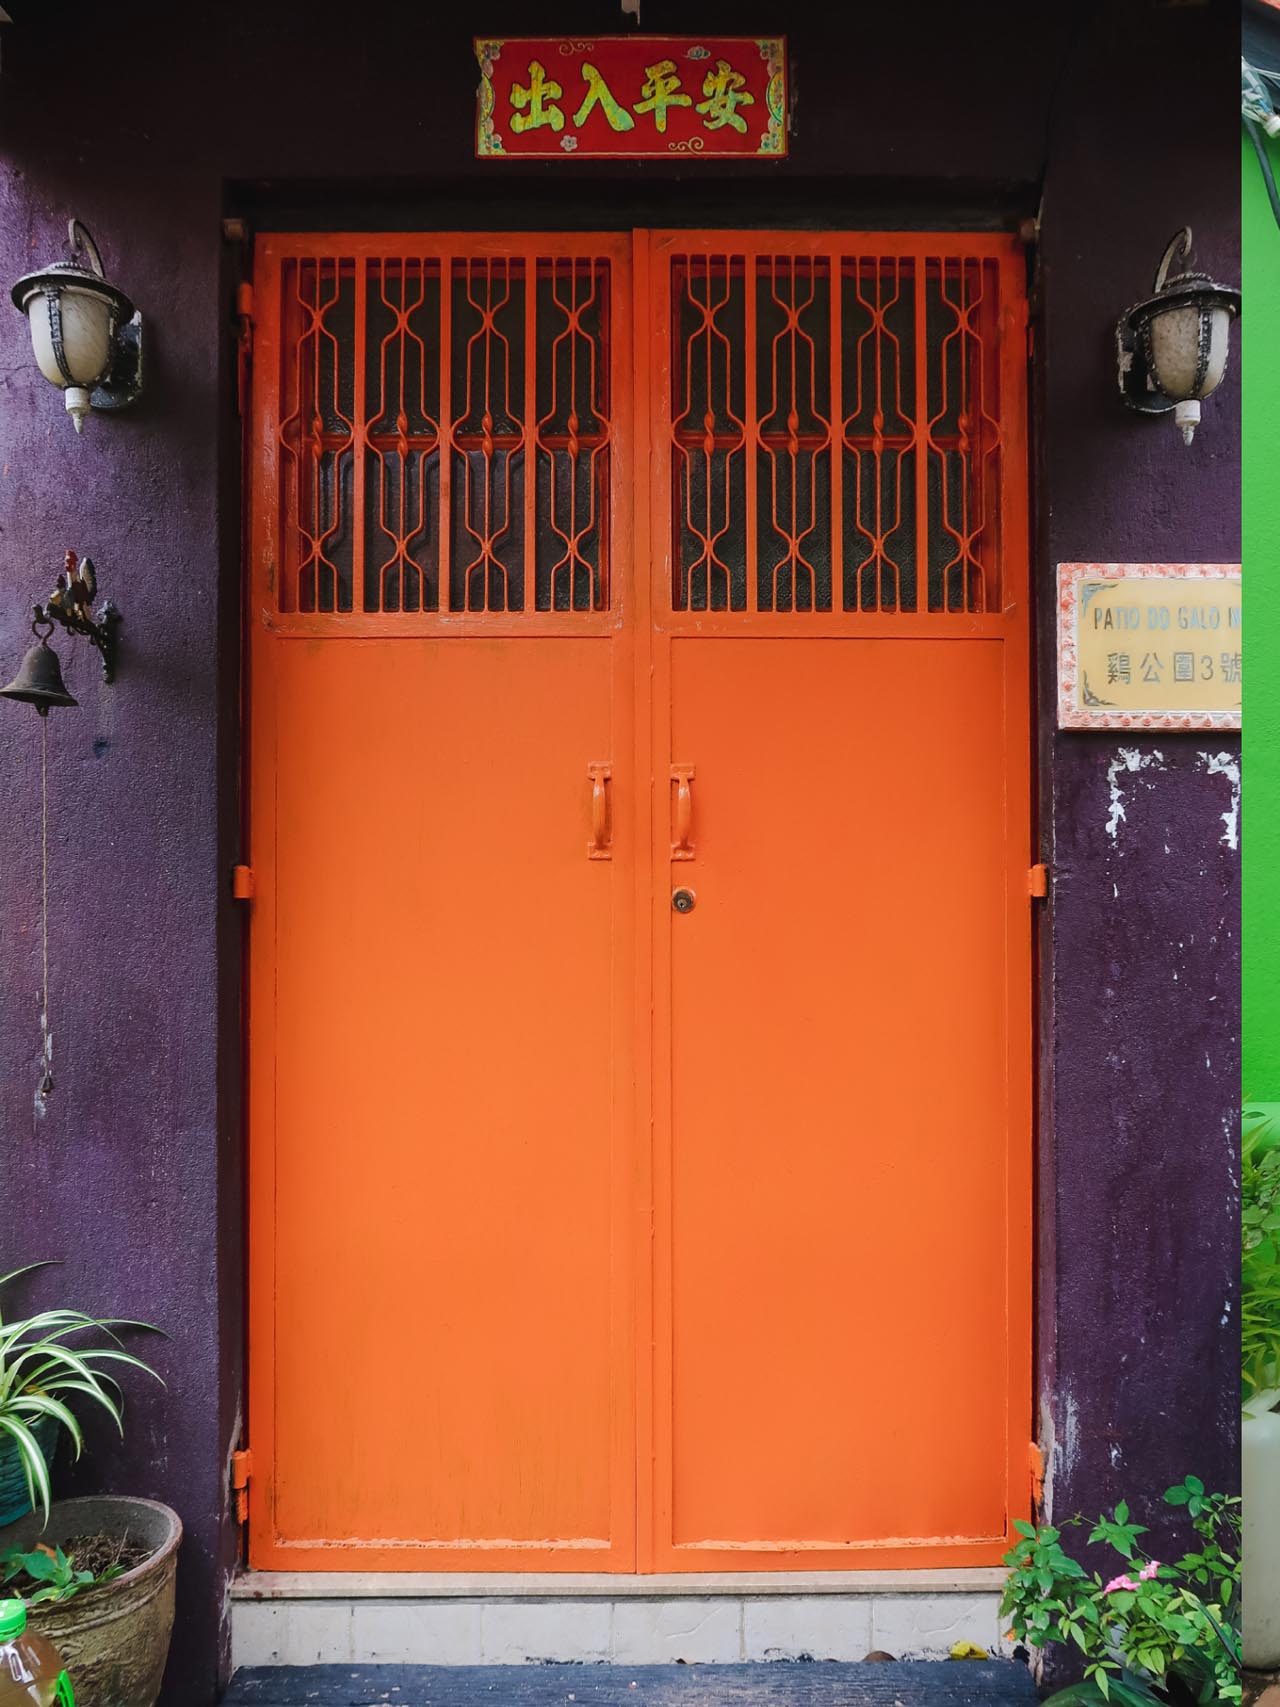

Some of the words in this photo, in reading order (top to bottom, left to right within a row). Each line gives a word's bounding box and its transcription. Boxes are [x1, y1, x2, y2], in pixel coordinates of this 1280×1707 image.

[509, 60, 754, 134] 出入平安
[1094, 607, 1140, 630] PATIO
[1148, 607, 1169, 630] DO
[1178, 607, 1220, 630] GALO
